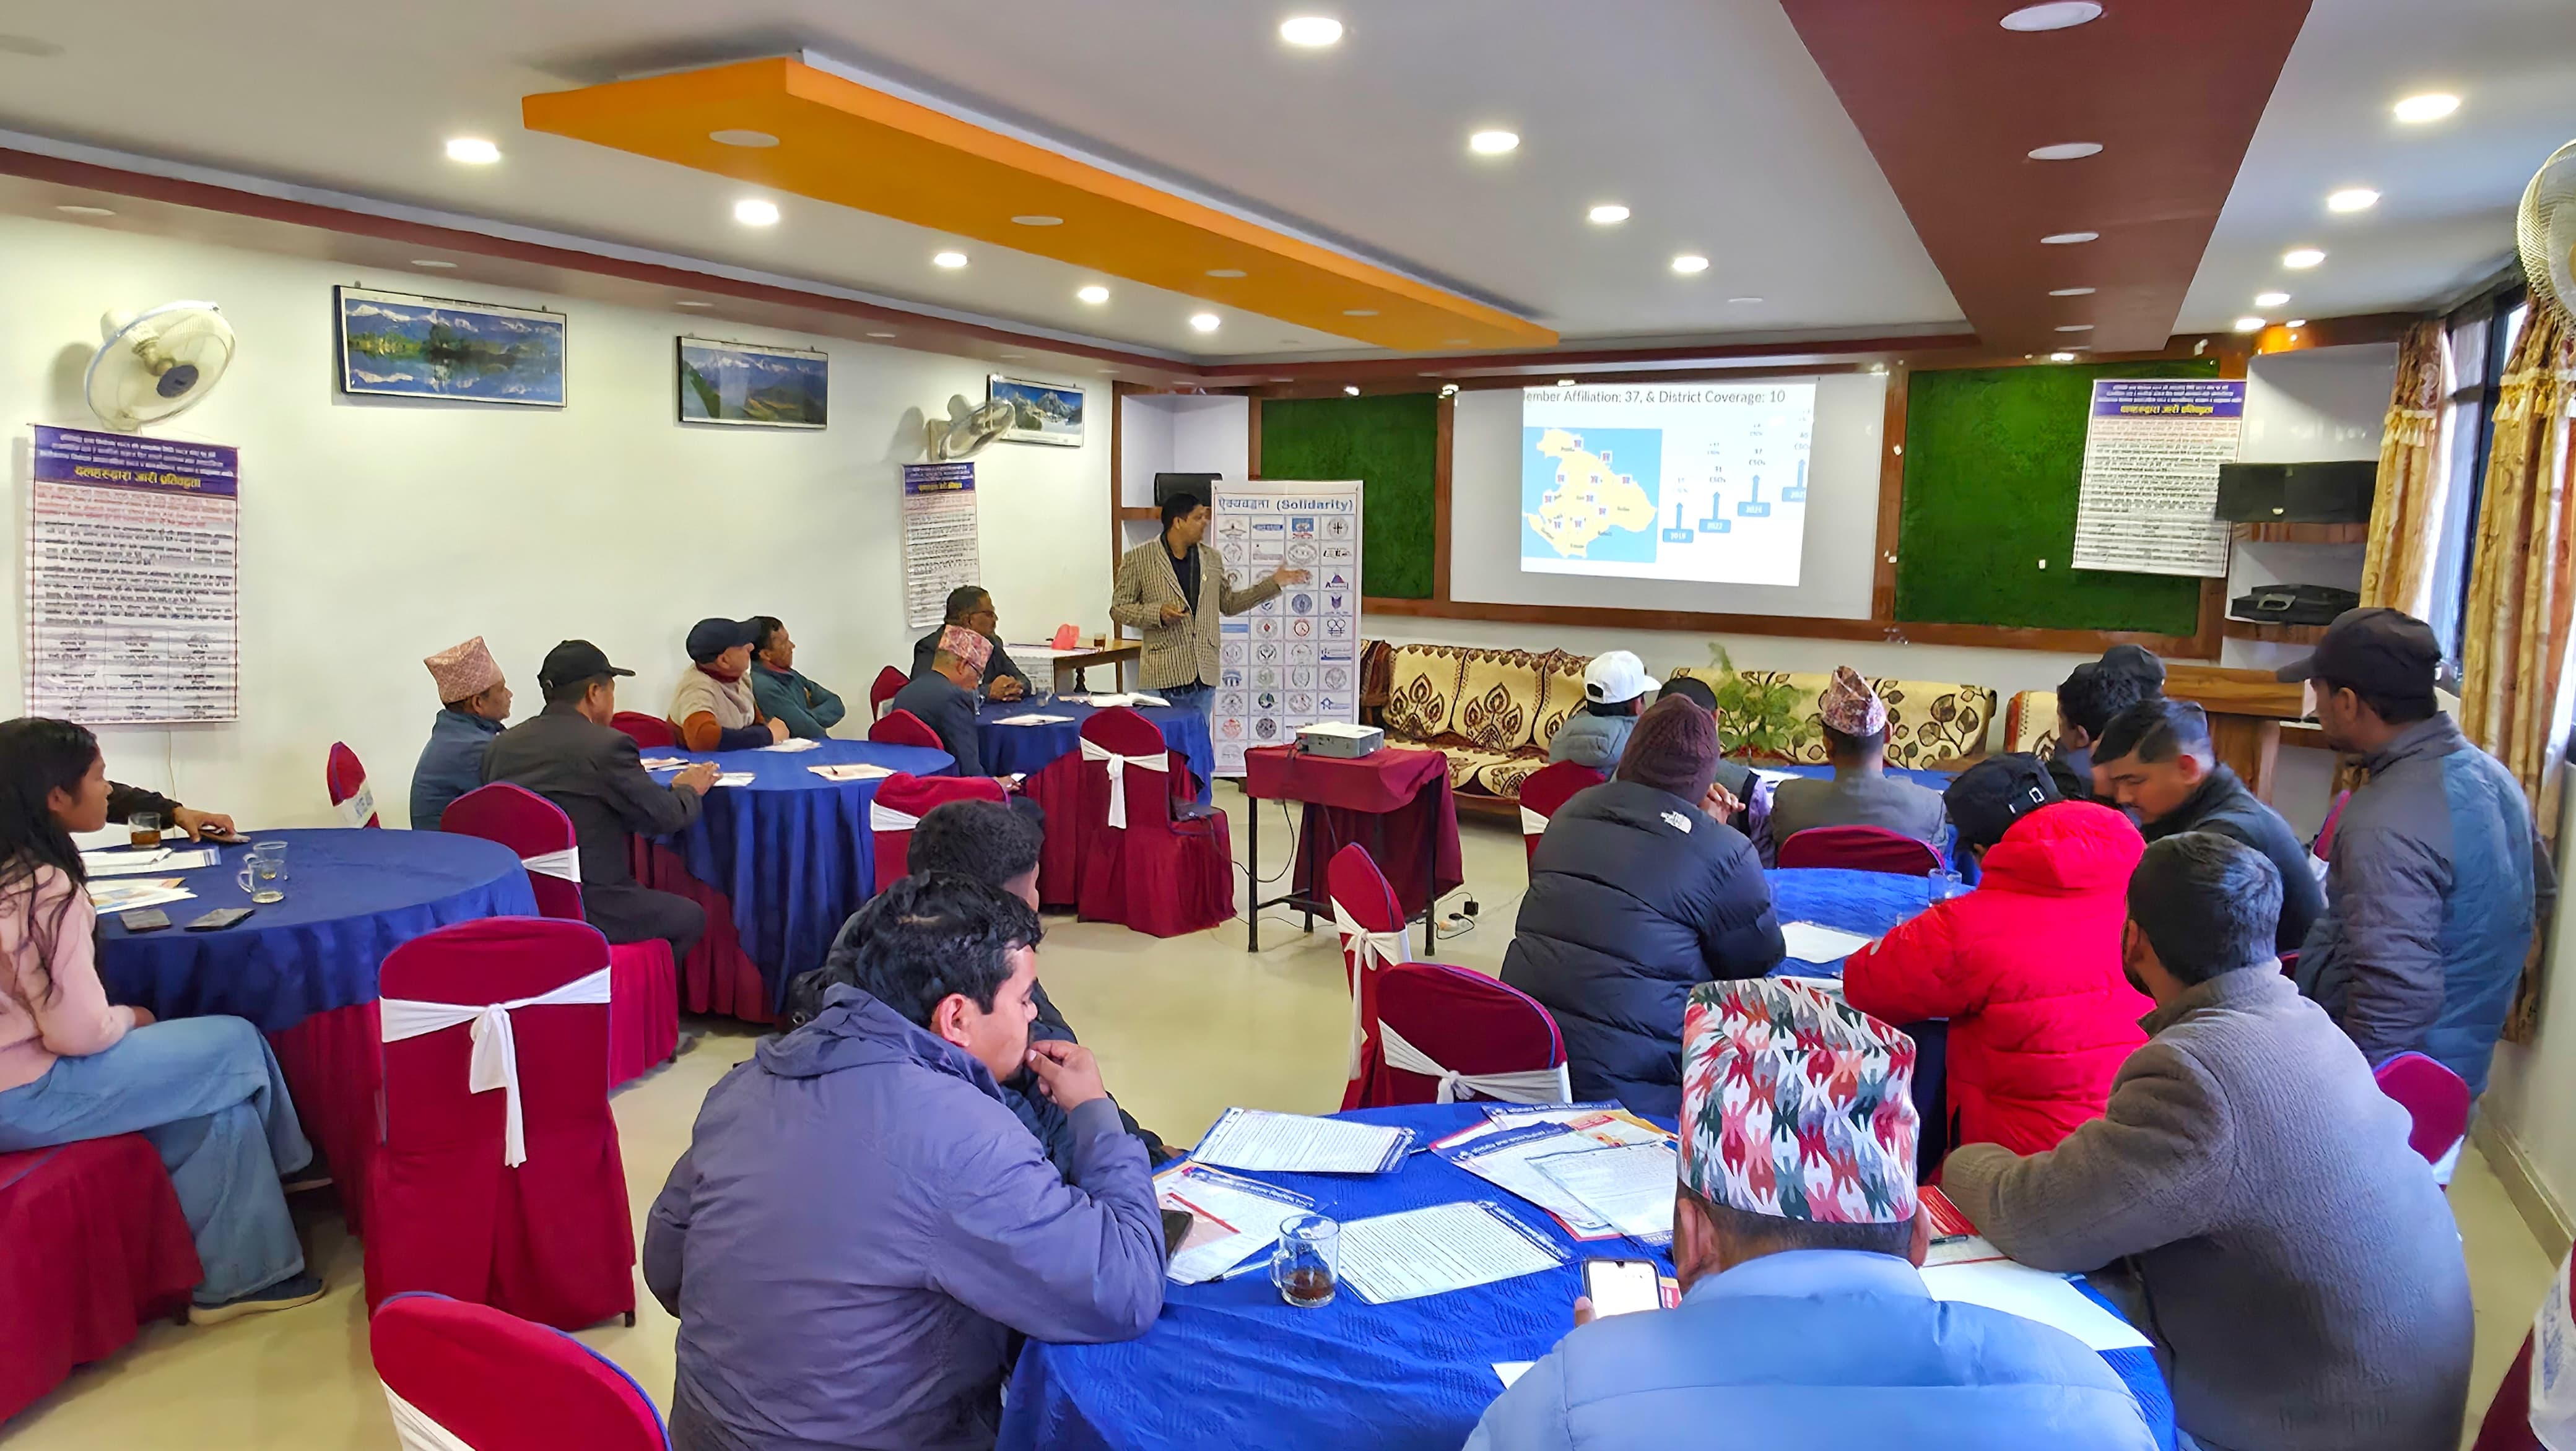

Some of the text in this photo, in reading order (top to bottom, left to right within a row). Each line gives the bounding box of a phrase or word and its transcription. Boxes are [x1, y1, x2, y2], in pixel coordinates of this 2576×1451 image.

[1523, 389, 1785, 405] ember Affiliation: 37, & District Coverage: 10
[1277, 499, 1353, 512] (Solidarity)
